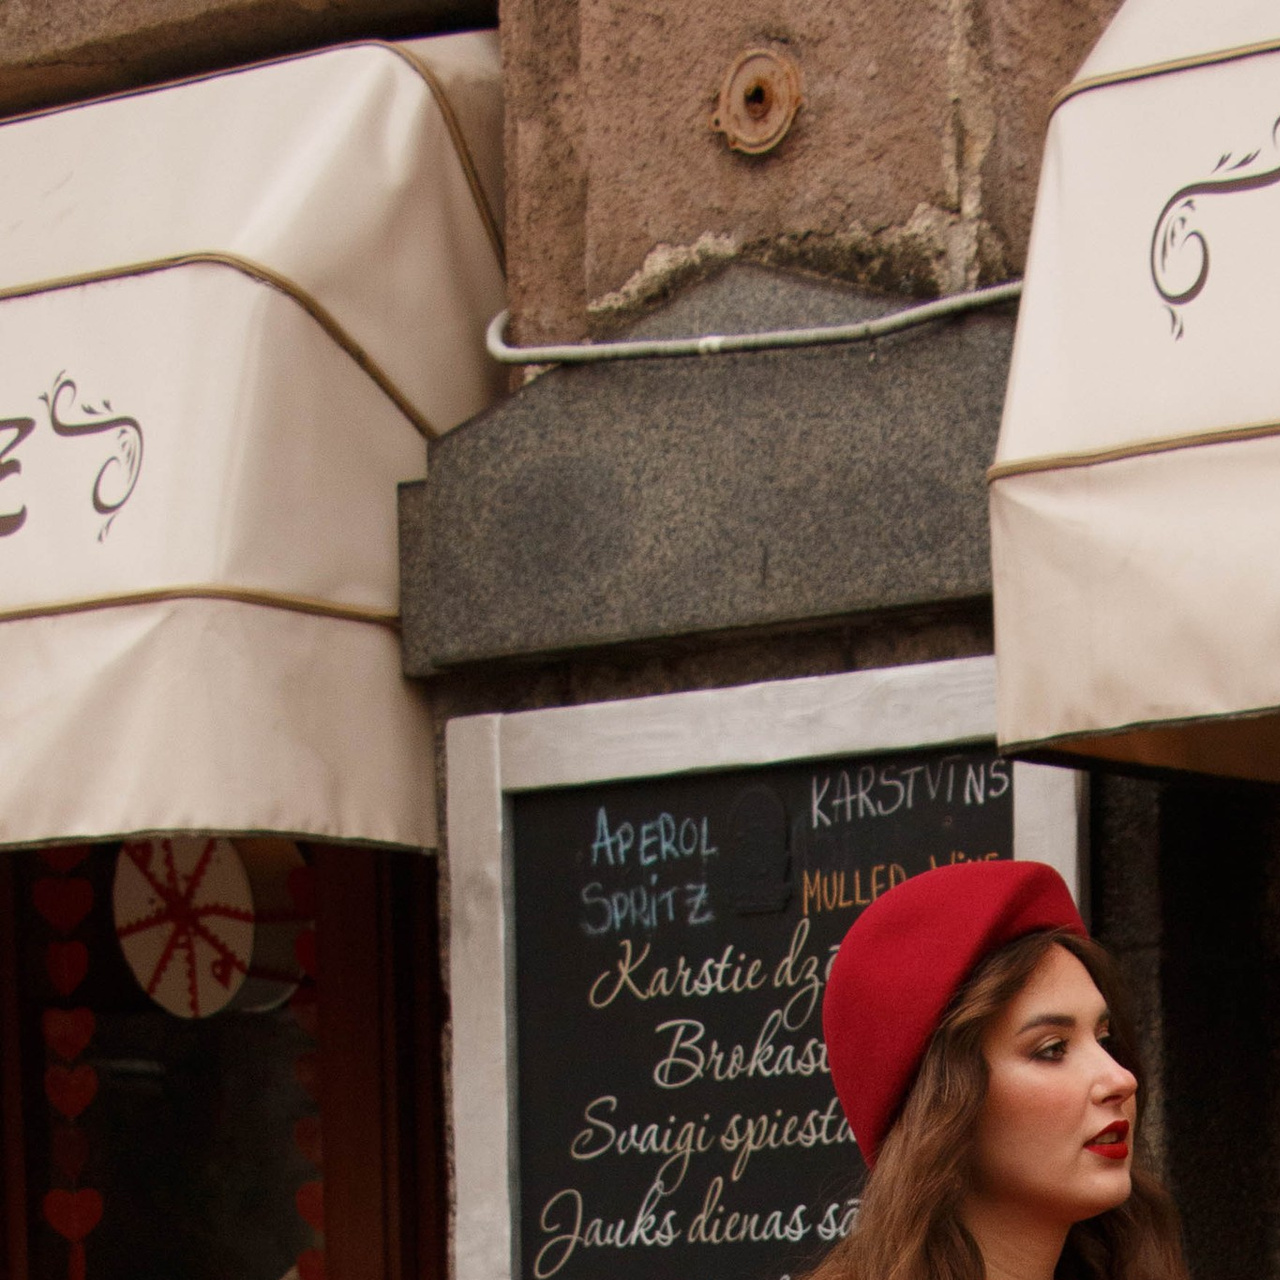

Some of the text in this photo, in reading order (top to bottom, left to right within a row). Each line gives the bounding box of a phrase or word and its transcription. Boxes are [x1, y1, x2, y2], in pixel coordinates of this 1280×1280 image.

[591, 806, 719, 866] APEROL
[589, 939, 767, 1009] Karstie
[571, 1096, 715, 1196] Svaigi
[534, 1180, 681, 1280] Jauks
[687, 1177, 812, 1243] dienas
